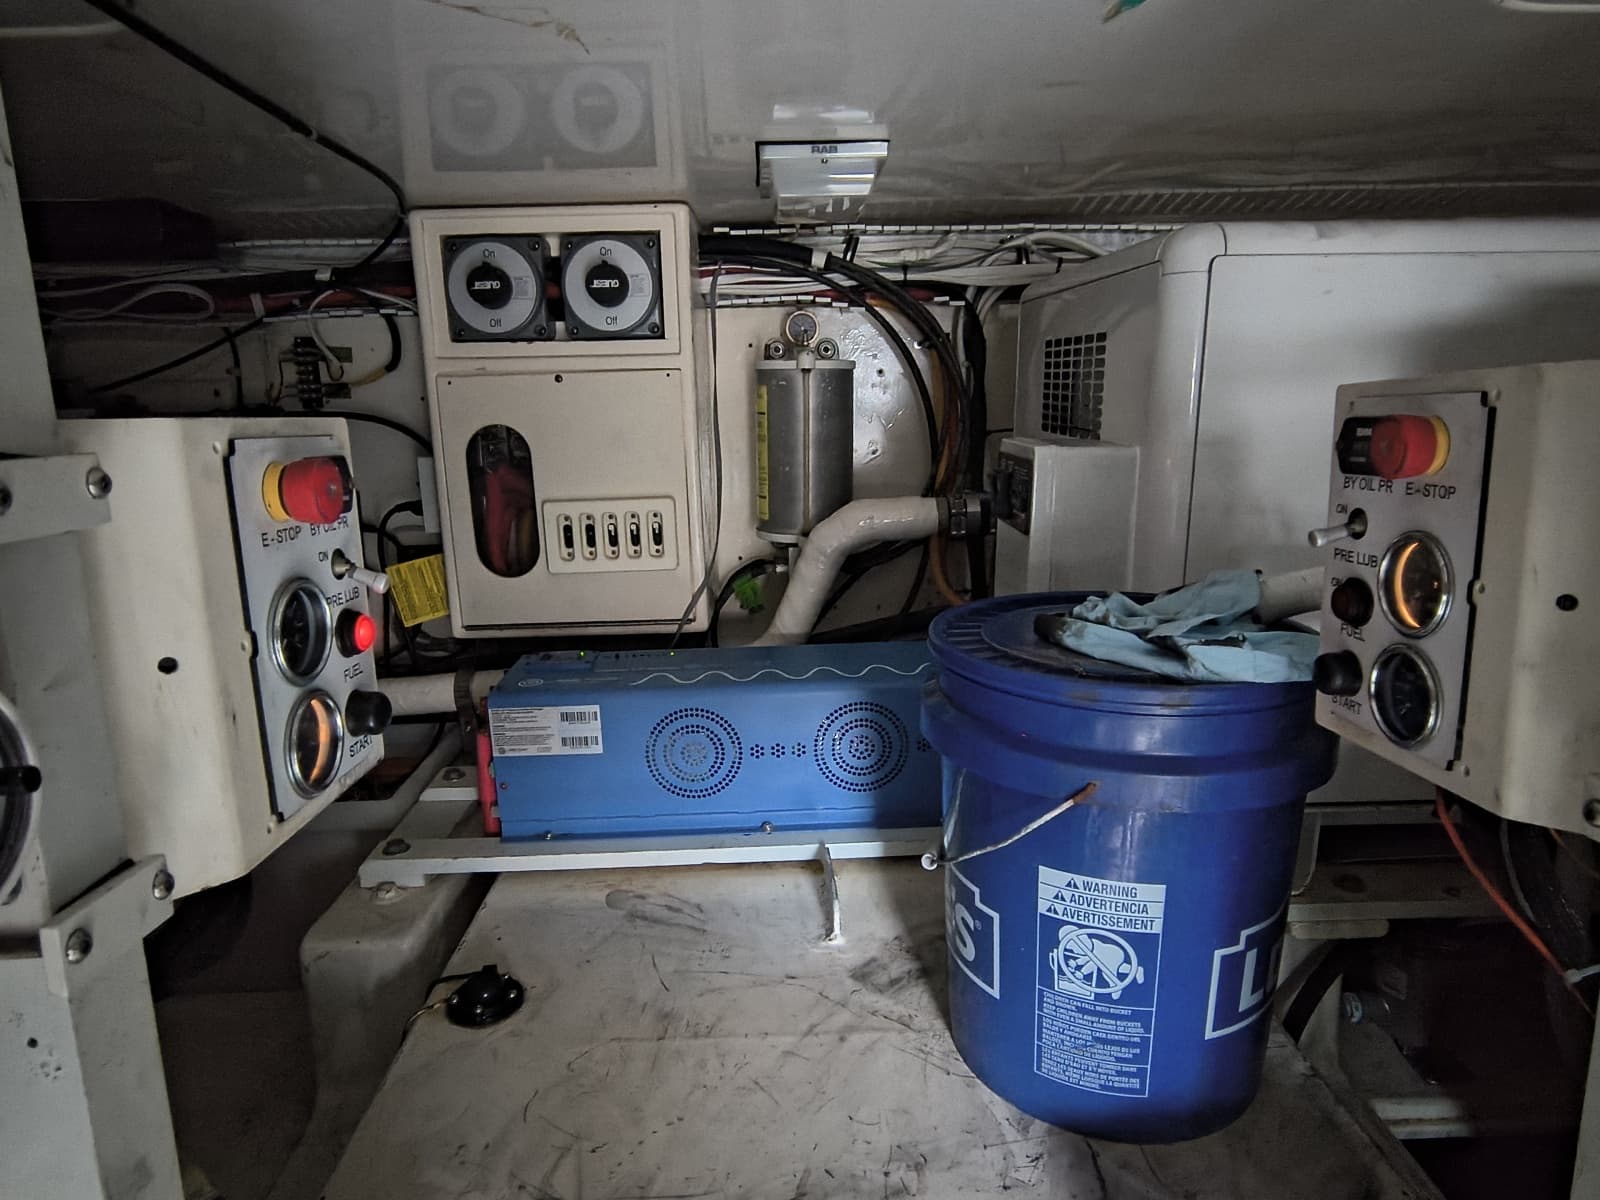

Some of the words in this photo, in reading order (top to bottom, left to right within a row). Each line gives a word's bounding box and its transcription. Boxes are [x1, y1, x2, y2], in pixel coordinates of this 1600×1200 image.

[811, 145, 838, 154] RAB
[483, 248, 496, 260] On
[600, 246, 612, 258] On
[490, 318, 502, 328] Off
[606, 316, 618, 326] Off
[1344, 476, 1356, 489] BY
[1359, 477, 1376, 492] OIL
[1378, 480, 1393, 494] PR
[1405, 482, 1456, 500] E-STOP
[1336, 504, 1348, 514] ON
[262, 526, 302, 548] E-STOP
[318, 552, 329, 562] ON
[1334, 548, 1354, 564] PRE
[1356, 552, 1378, 568] LUB
[328, 592, 344, 608] PRE
[344, 586, 360, 603] LUB
[1340, 622, 1366, 642] FUEL
[343, 662, 364, 684] FUEL
[349, 734, 373, 758] START
[1082, 880, 1138, 898] WARNING
[1069, 893, 1149, 915] ADVERTENCIA
[1062, 906, 1156, 931] AVERTISSEMENT
